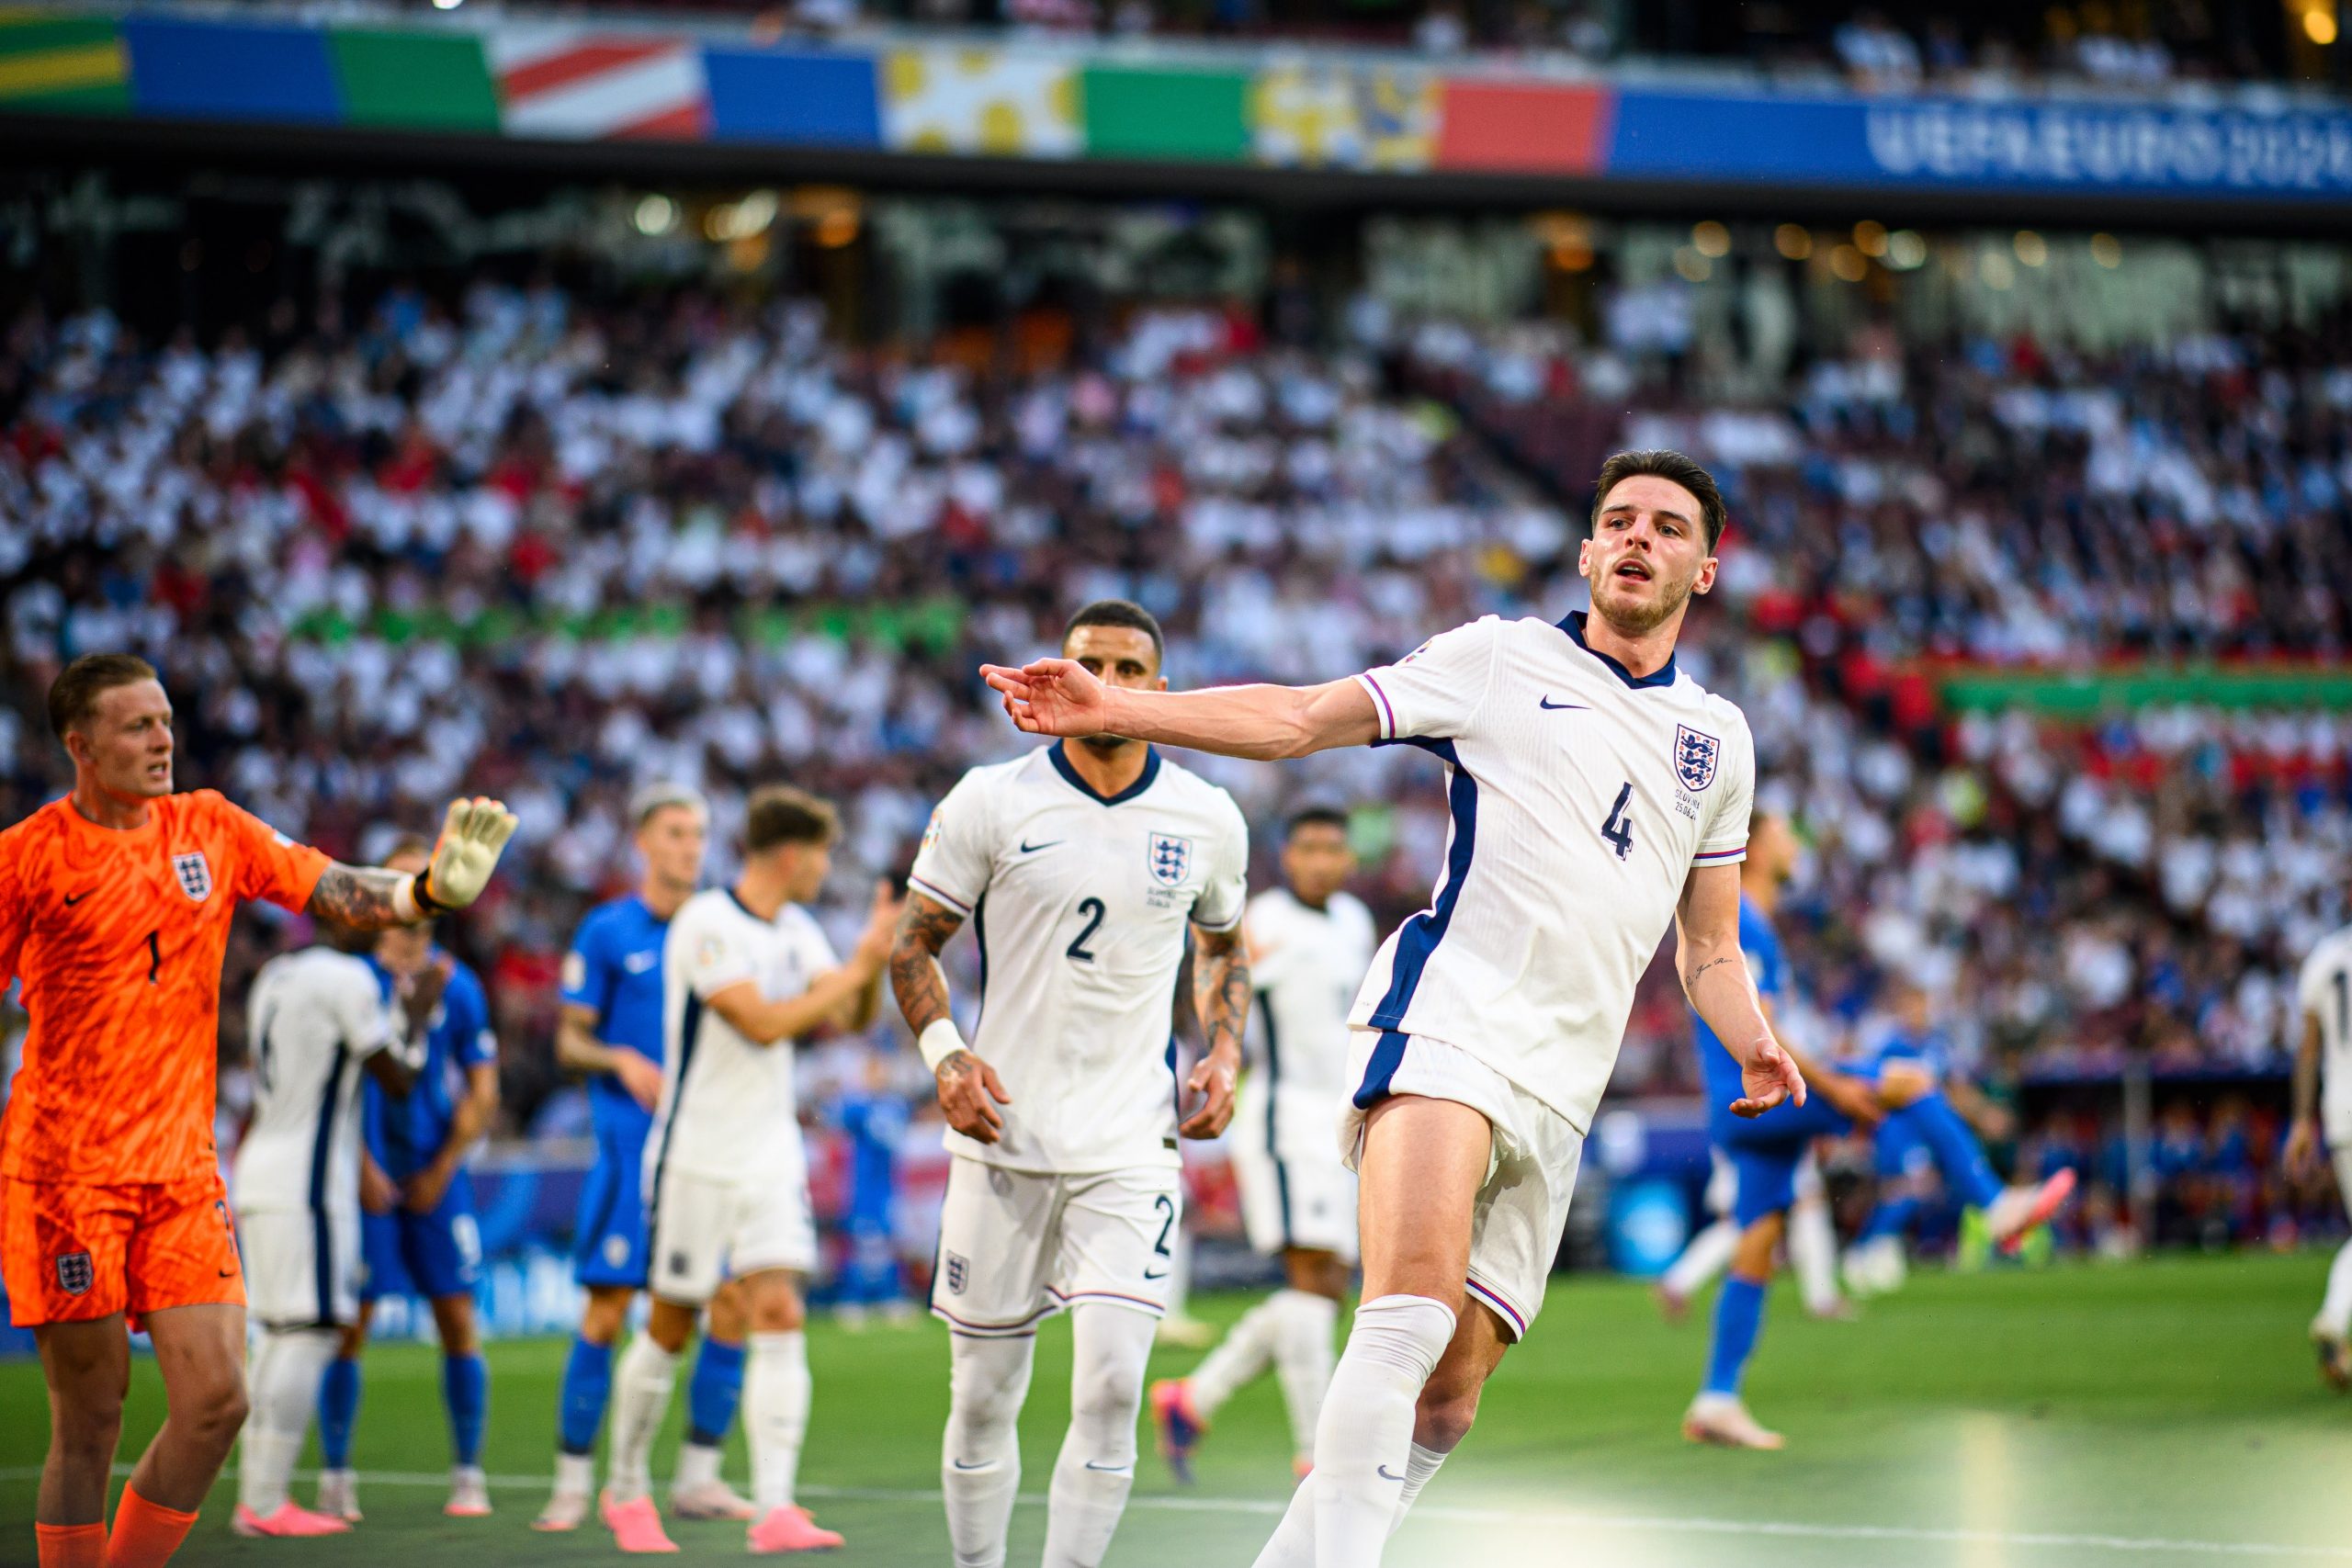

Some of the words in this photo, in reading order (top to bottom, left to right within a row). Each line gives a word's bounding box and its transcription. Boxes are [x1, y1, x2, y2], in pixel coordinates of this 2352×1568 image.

[1601, 782, 1634, 862] 4
[143, 931, 160, 983] 1
[1067, 897, 1106, 963] 2
[1155, 1194, 1173, 1256] 2
